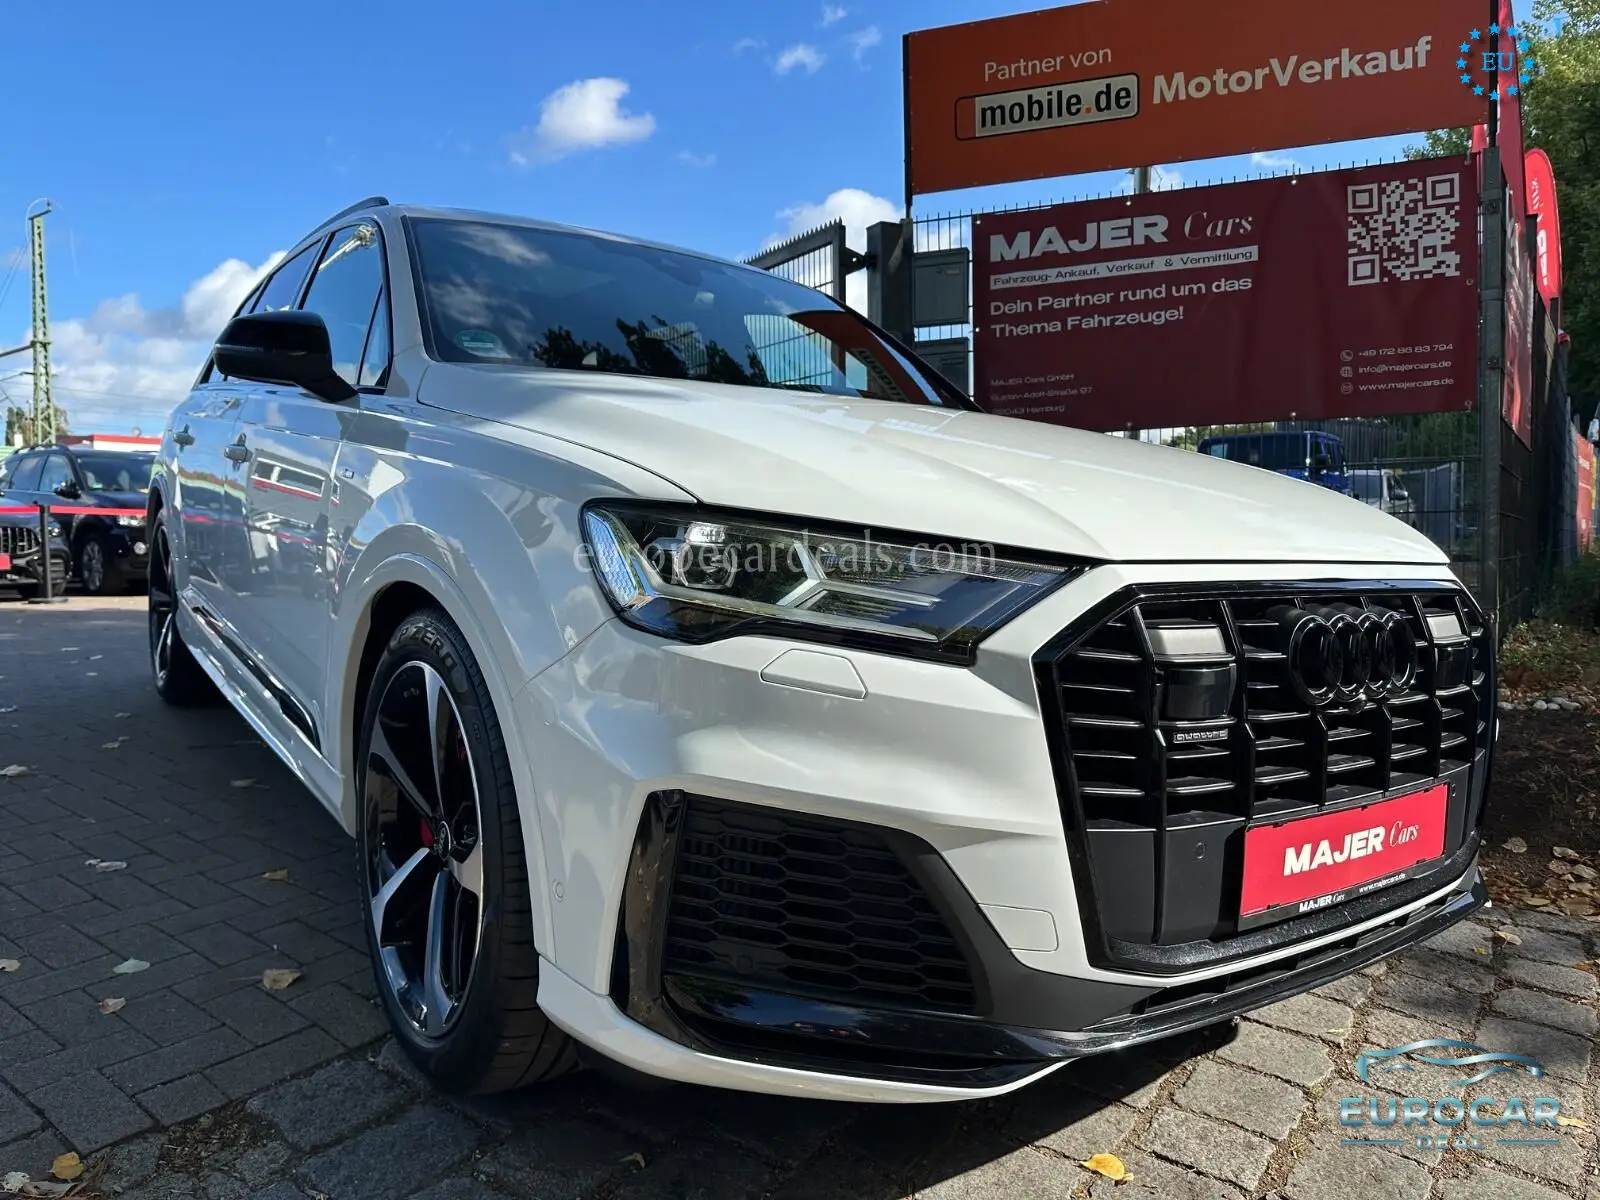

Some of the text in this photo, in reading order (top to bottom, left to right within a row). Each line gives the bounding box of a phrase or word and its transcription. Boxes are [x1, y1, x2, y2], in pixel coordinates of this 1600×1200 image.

[984, 48, 1112, 82] Partner von
[1152, 35, 1432, 105] MotorVerkauf
[980, 83, 1131, 129] mobile.de
[989, 210, 1253, 263] MAJER Cars
[993, 248, 1253, 287] Fahrzeug- Ankauf, Verkauf & Vermittlung
[990, 277, 1253, 317] Dein Partner rund um das
[990, 305, 1185, 339] Thema Fahrzeuge!
[1358, 360, 1452, 374] info@majercars.de
[1359, 377, 1455, 391] www.majercars.de
[1283, 820, 1421, 877] MAJER Cars
[1358, 873, 1406, 893] www.majercars.de
[1298, 894, 1333, 913] MAJER
